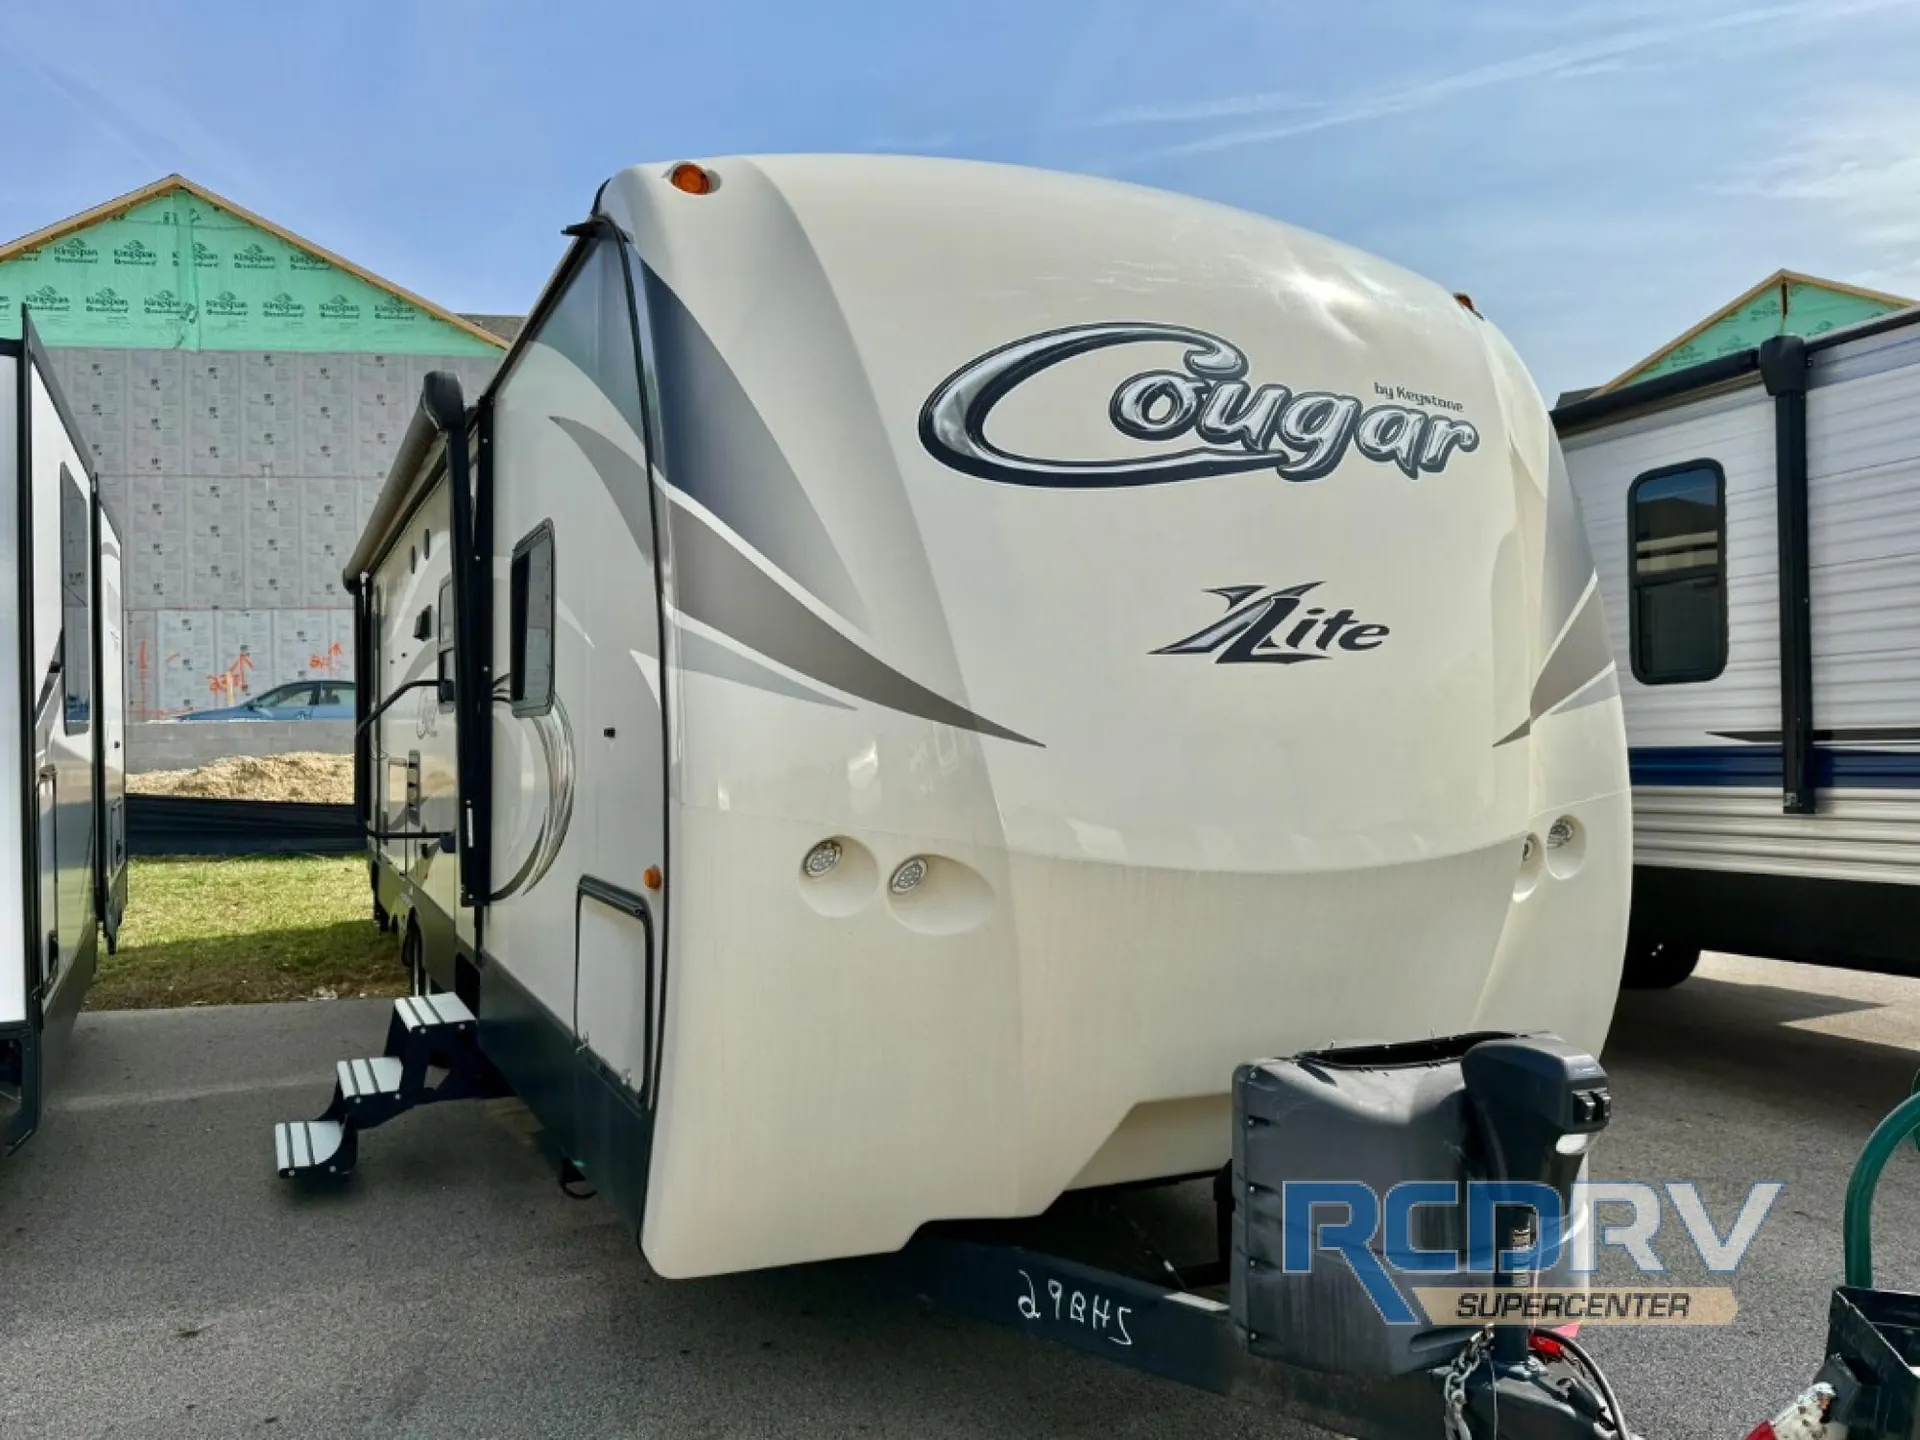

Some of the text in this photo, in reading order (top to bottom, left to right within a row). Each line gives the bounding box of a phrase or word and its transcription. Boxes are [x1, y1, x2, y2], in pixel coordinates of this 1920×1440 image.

[918, 322, 1479, 488] Cougar
[1373, 381, 1465, 413] by Keystone
[1017, 1267, 1134, 1346] 29BHS
